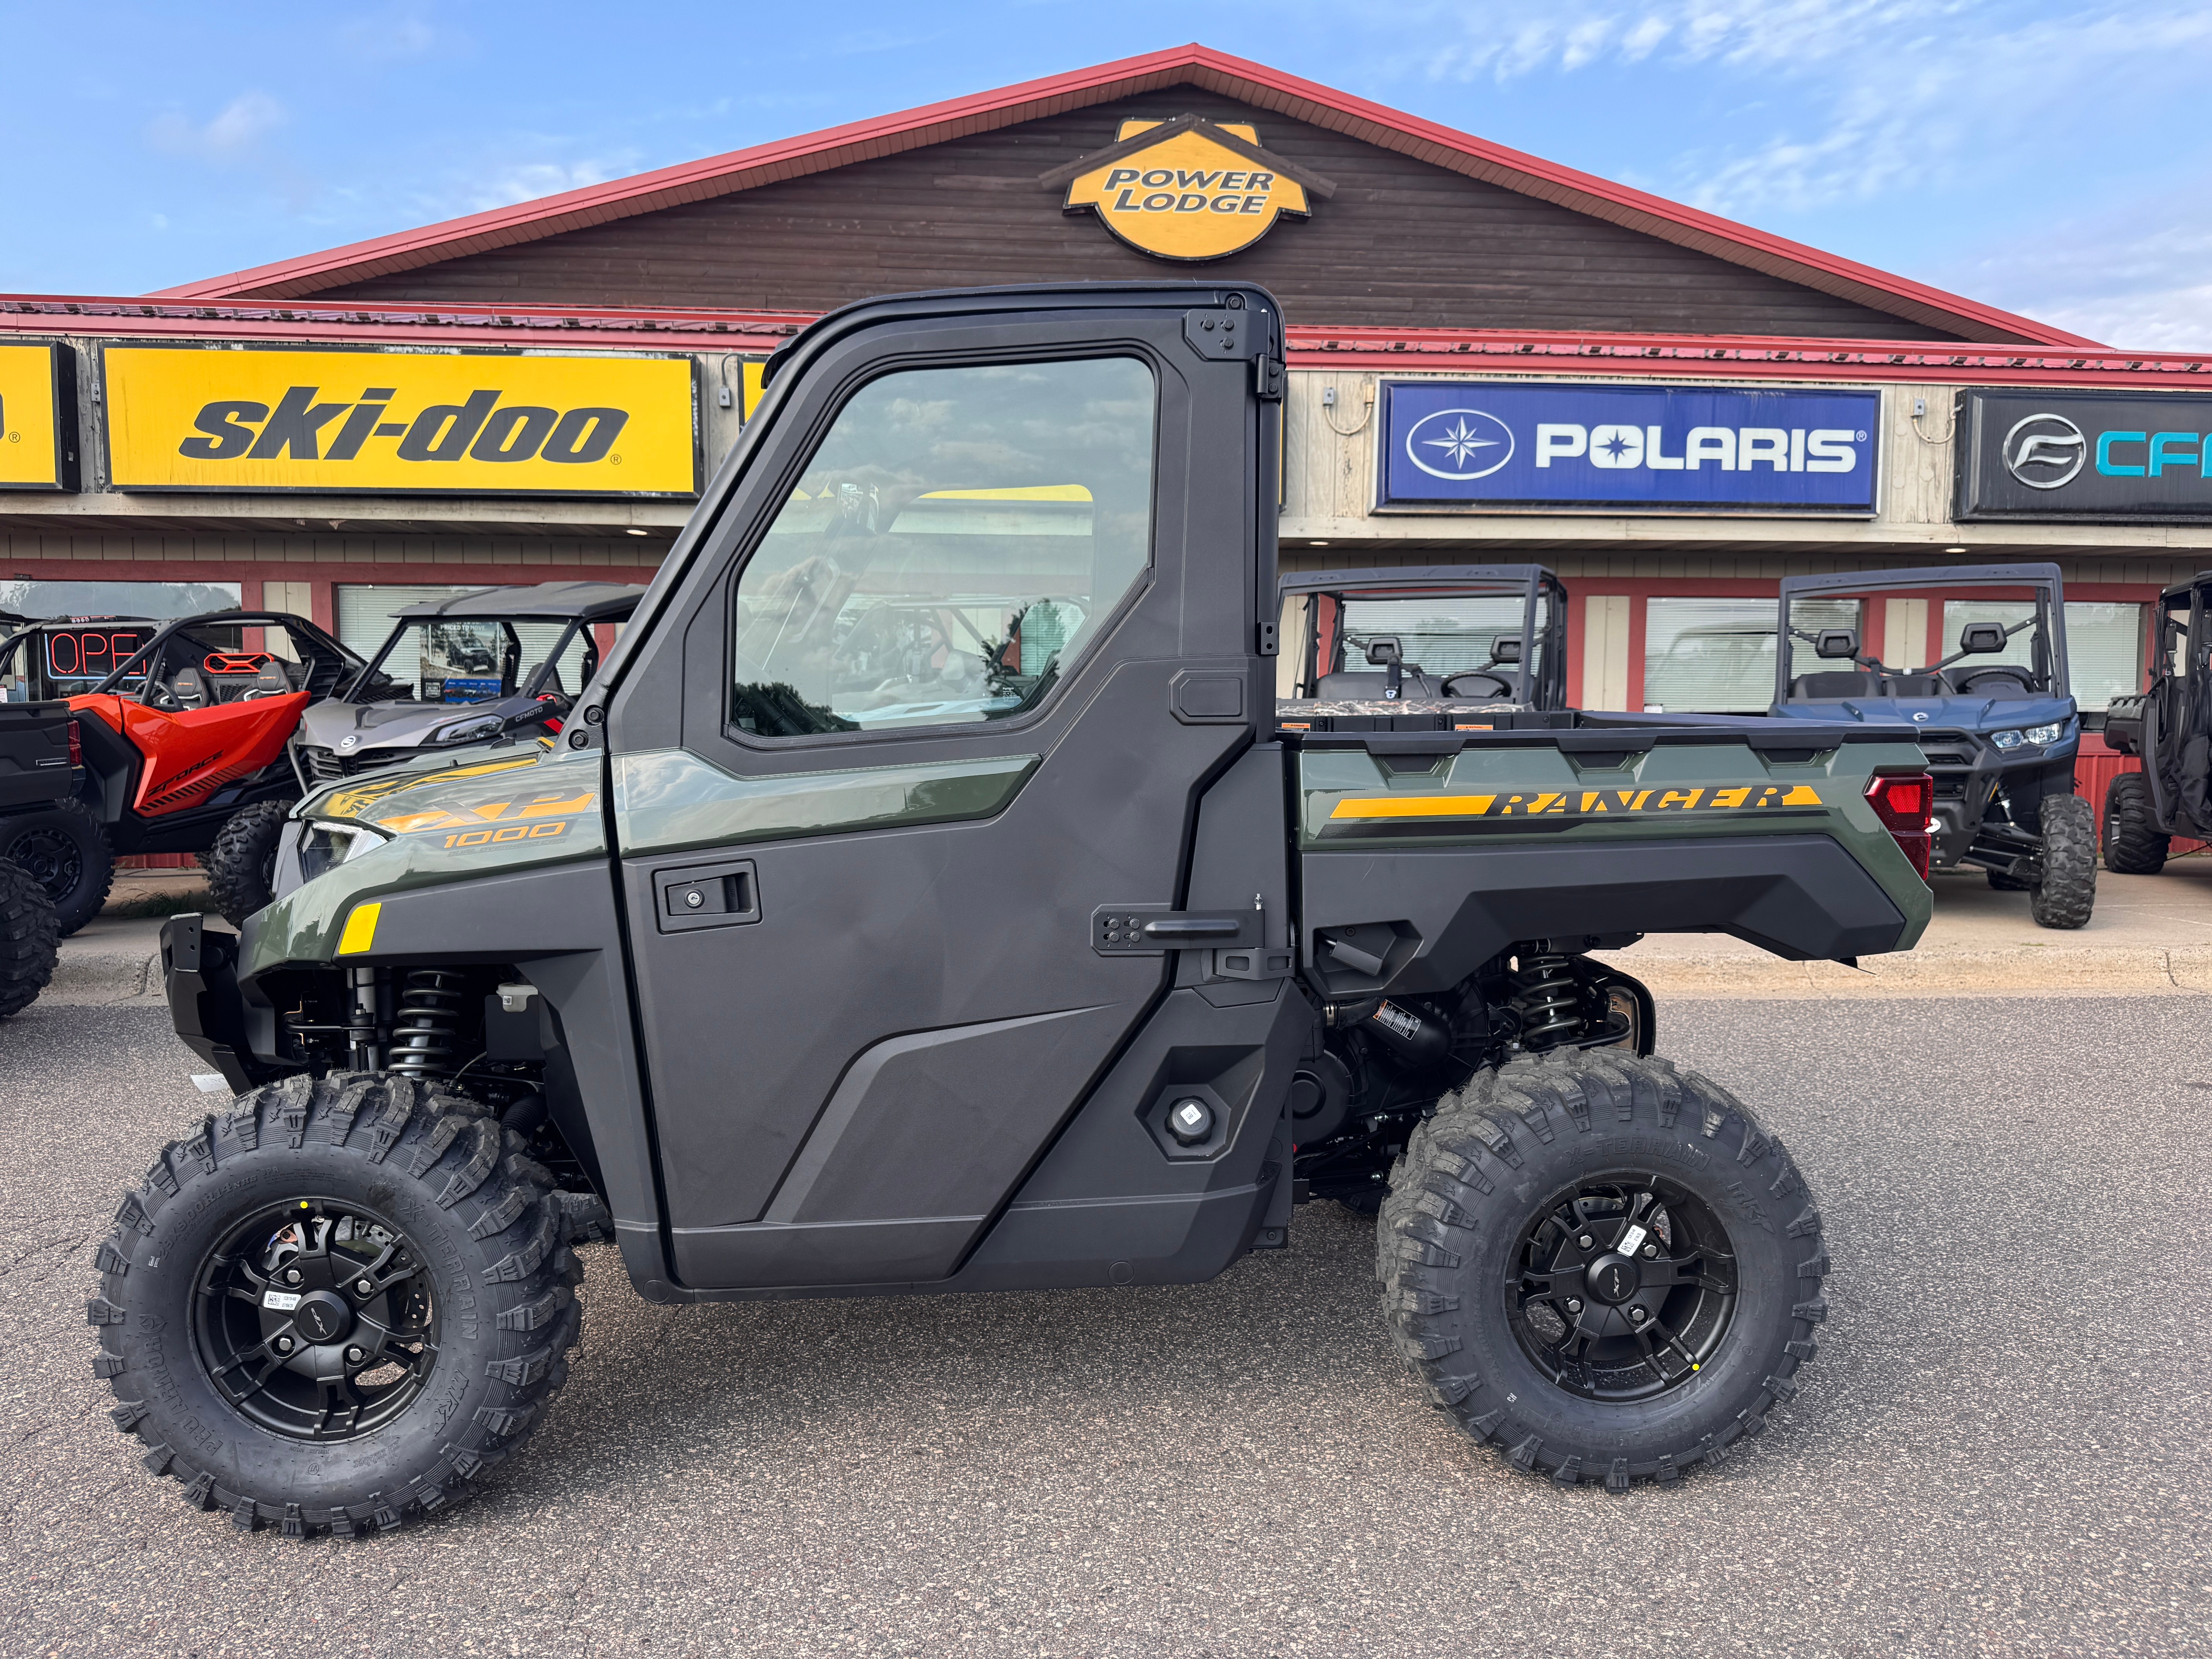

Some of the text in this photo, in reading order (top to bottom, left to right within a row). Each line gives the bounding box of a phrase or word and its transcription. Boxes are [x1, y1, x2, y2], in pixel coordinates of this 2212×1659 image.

[1103, 168, 1275, 192] POWER
[1112, 188, 1267, 215] LODGE
[1536, 424, 1856, 472] POLARIS
[2095, 431, 2212, 478] CF
[52, 633, 146, 674] OPE
[515, 706, 543, 722] CFMOTO
[407, 787, 588, 830] XP
[1484, 785, 1795, 817] RANGER
[444, 822, 566, 848] 1000
[447, 848, 476, 857] DUAL
[1563, 1135, 1712, 1172] X-TERRAIN
[234, 1175, 258, 1190] NHS
[400, 1199, 478, 1340] X-TERRAIN
[311, 1308, 327, 1335] XP
[144, 1336, 223, 1456] PRO ARMOR
[354, 1446, 388, 1468] rubber
